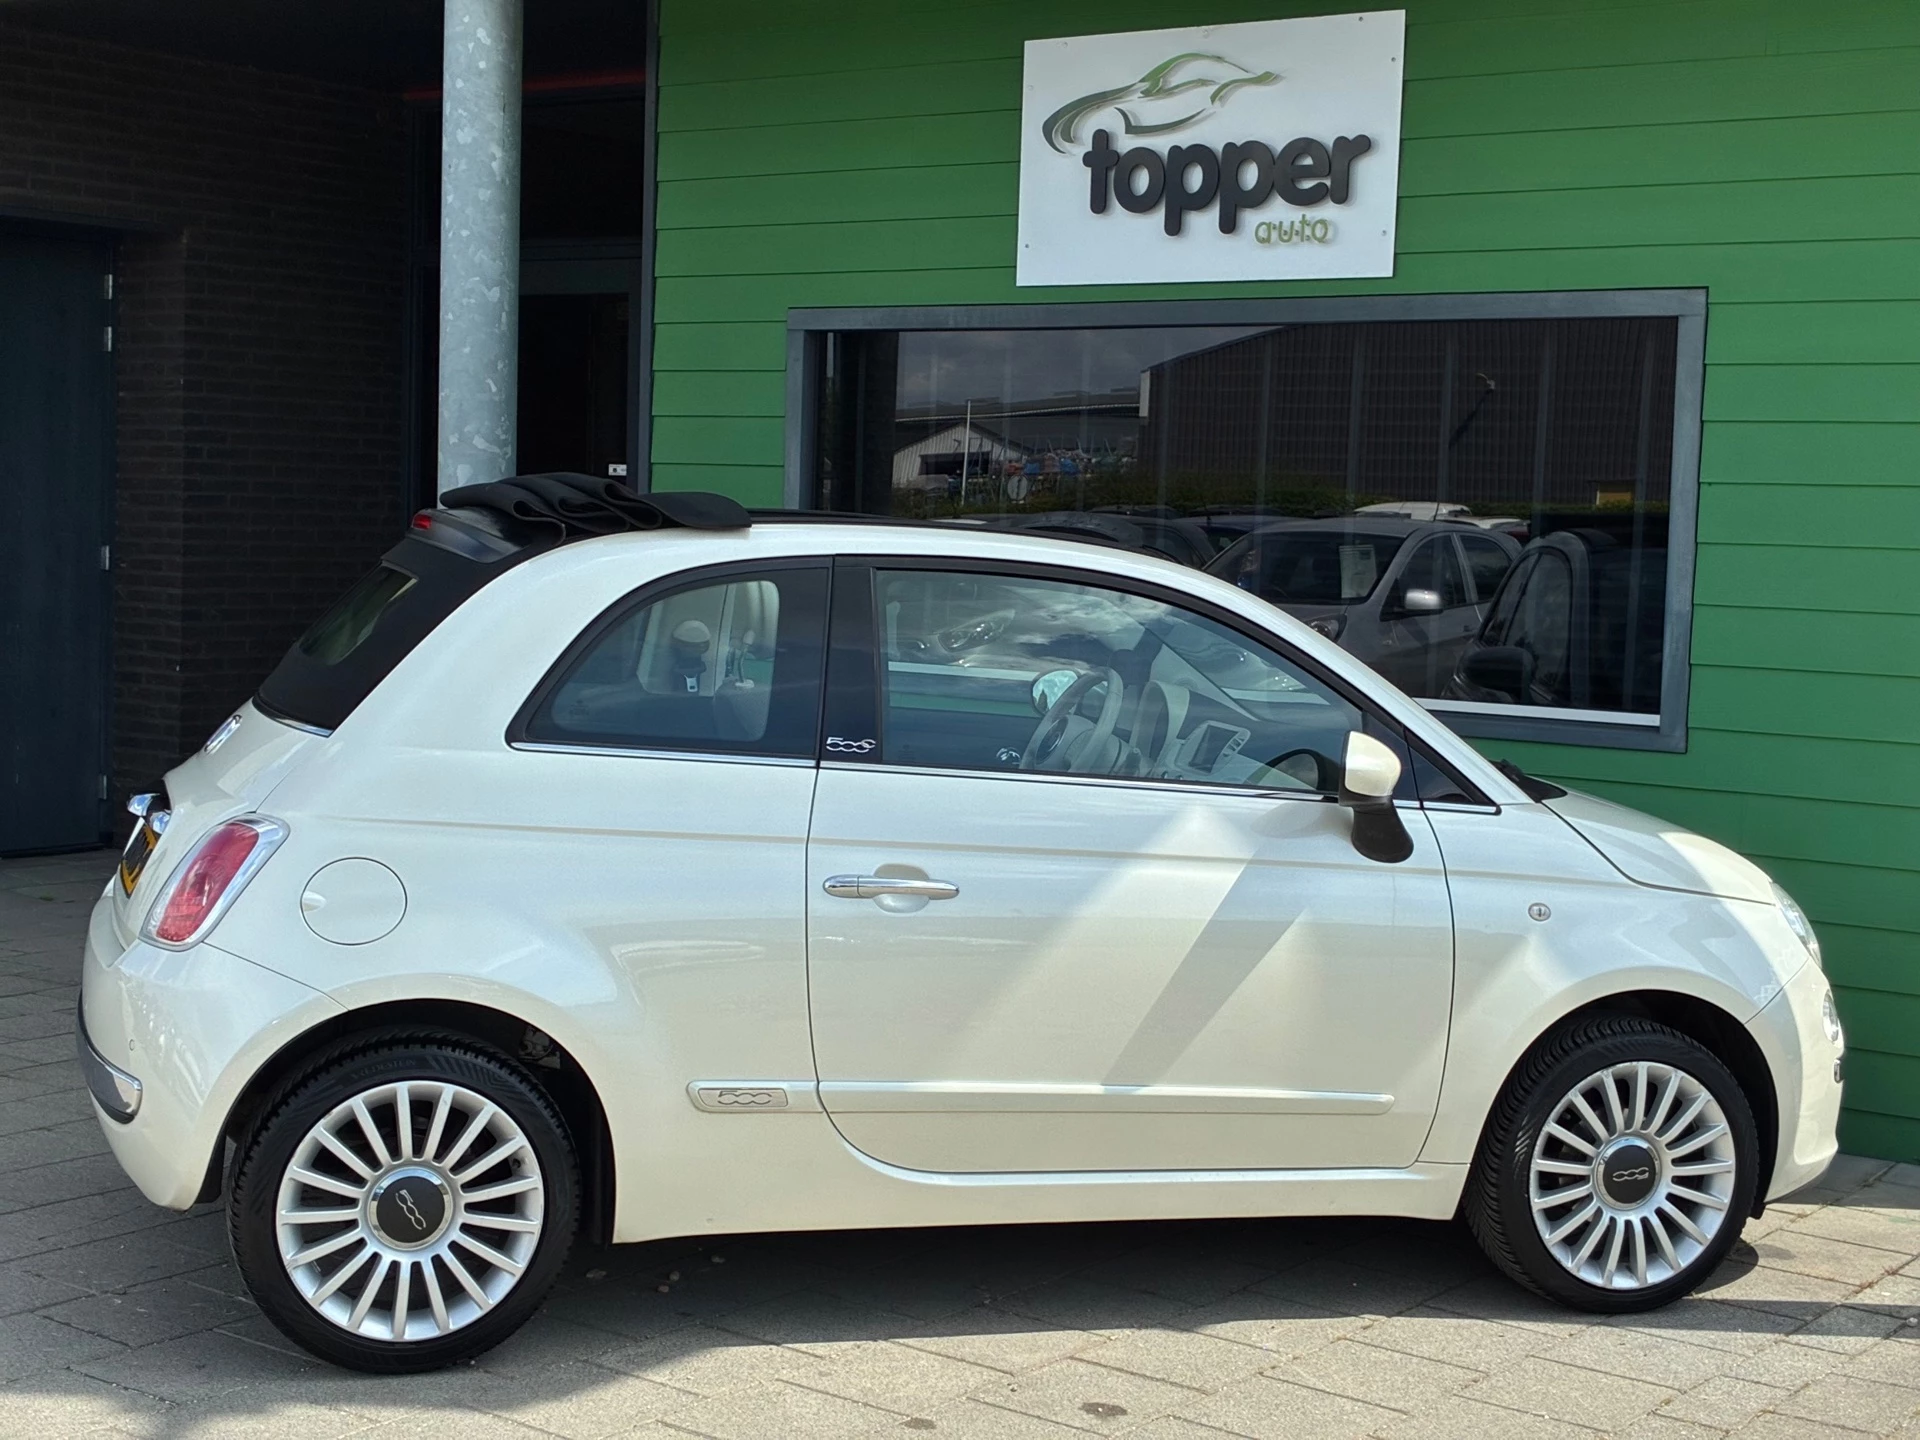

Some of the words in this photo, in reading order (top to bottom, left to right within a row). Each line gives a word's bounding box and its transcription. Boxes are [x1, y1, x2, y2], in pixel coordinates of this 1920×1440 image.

[1083, 129, 1371, 236] topper
[1255, 214, 1329, 244] auto
[718, 1091, 772, 1105] 500
